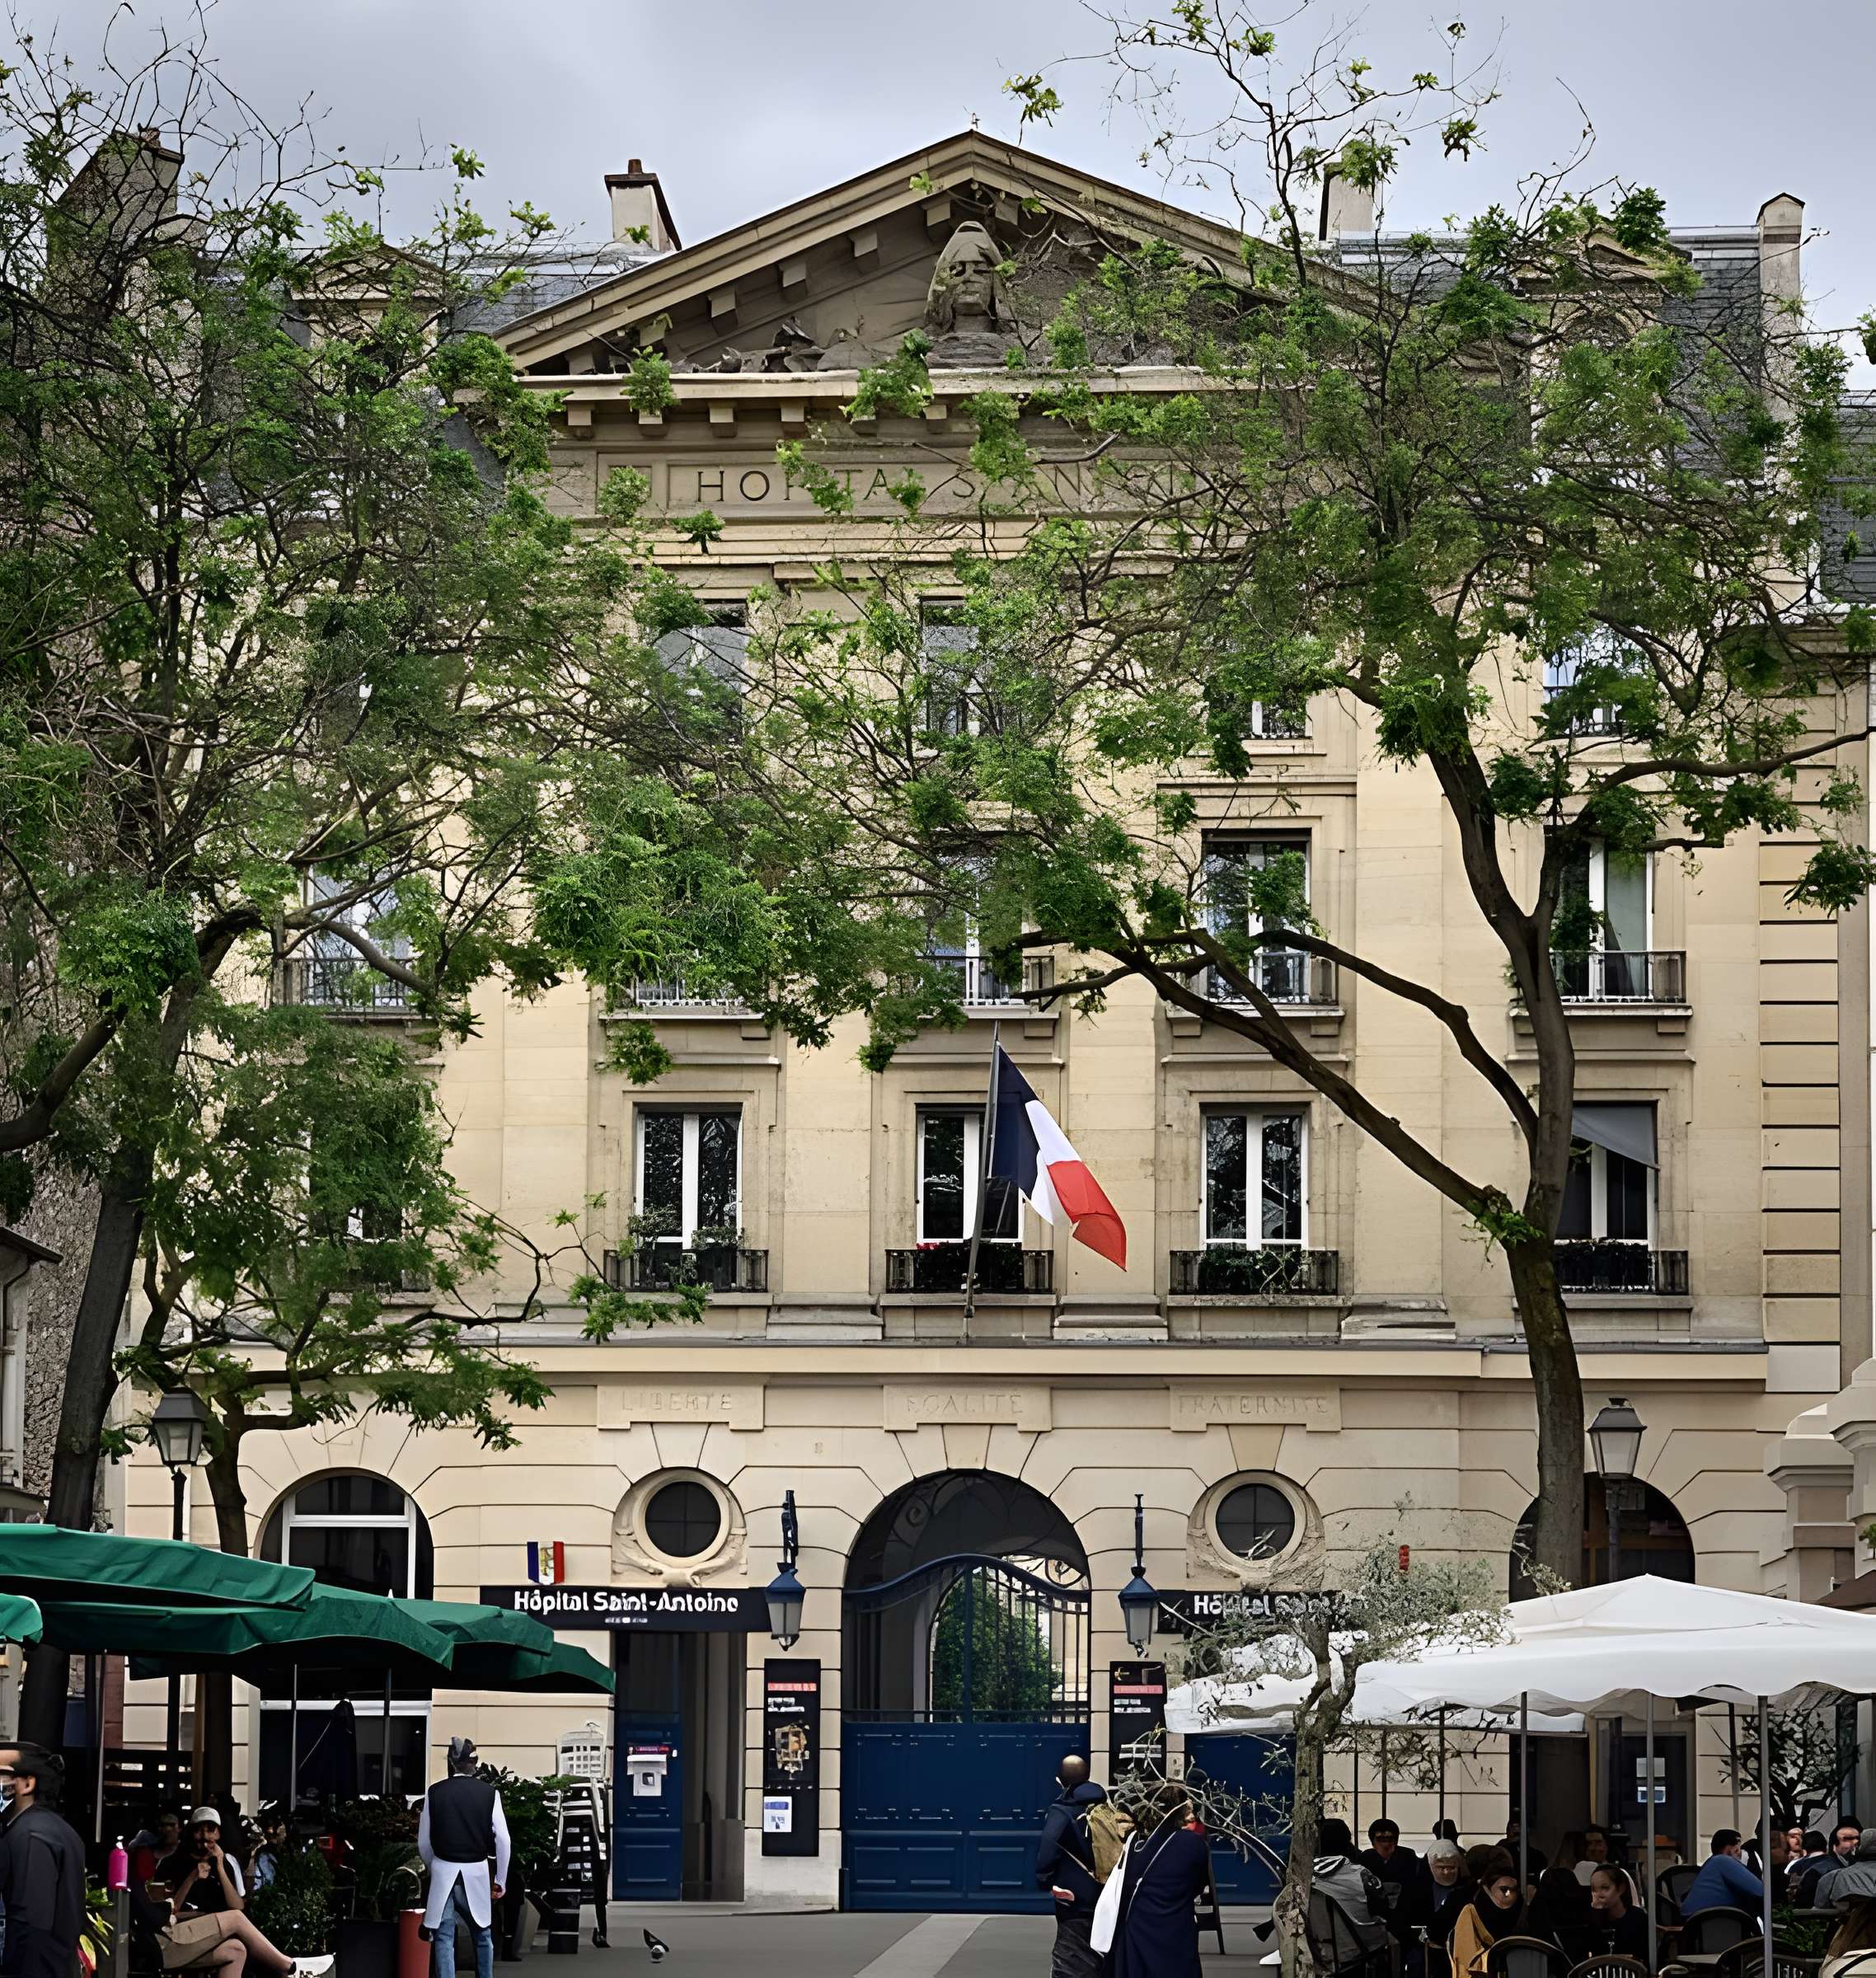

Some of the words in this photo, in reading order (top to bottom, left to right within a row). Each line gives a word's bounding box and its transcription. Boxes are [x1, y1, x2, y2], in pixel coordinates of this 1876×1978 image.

[697, 468, 918, 501] HOTA
[514, 1590, 589, 1615] Hôpital
[593, 1591, 739, 1612] Saint-Antoine
